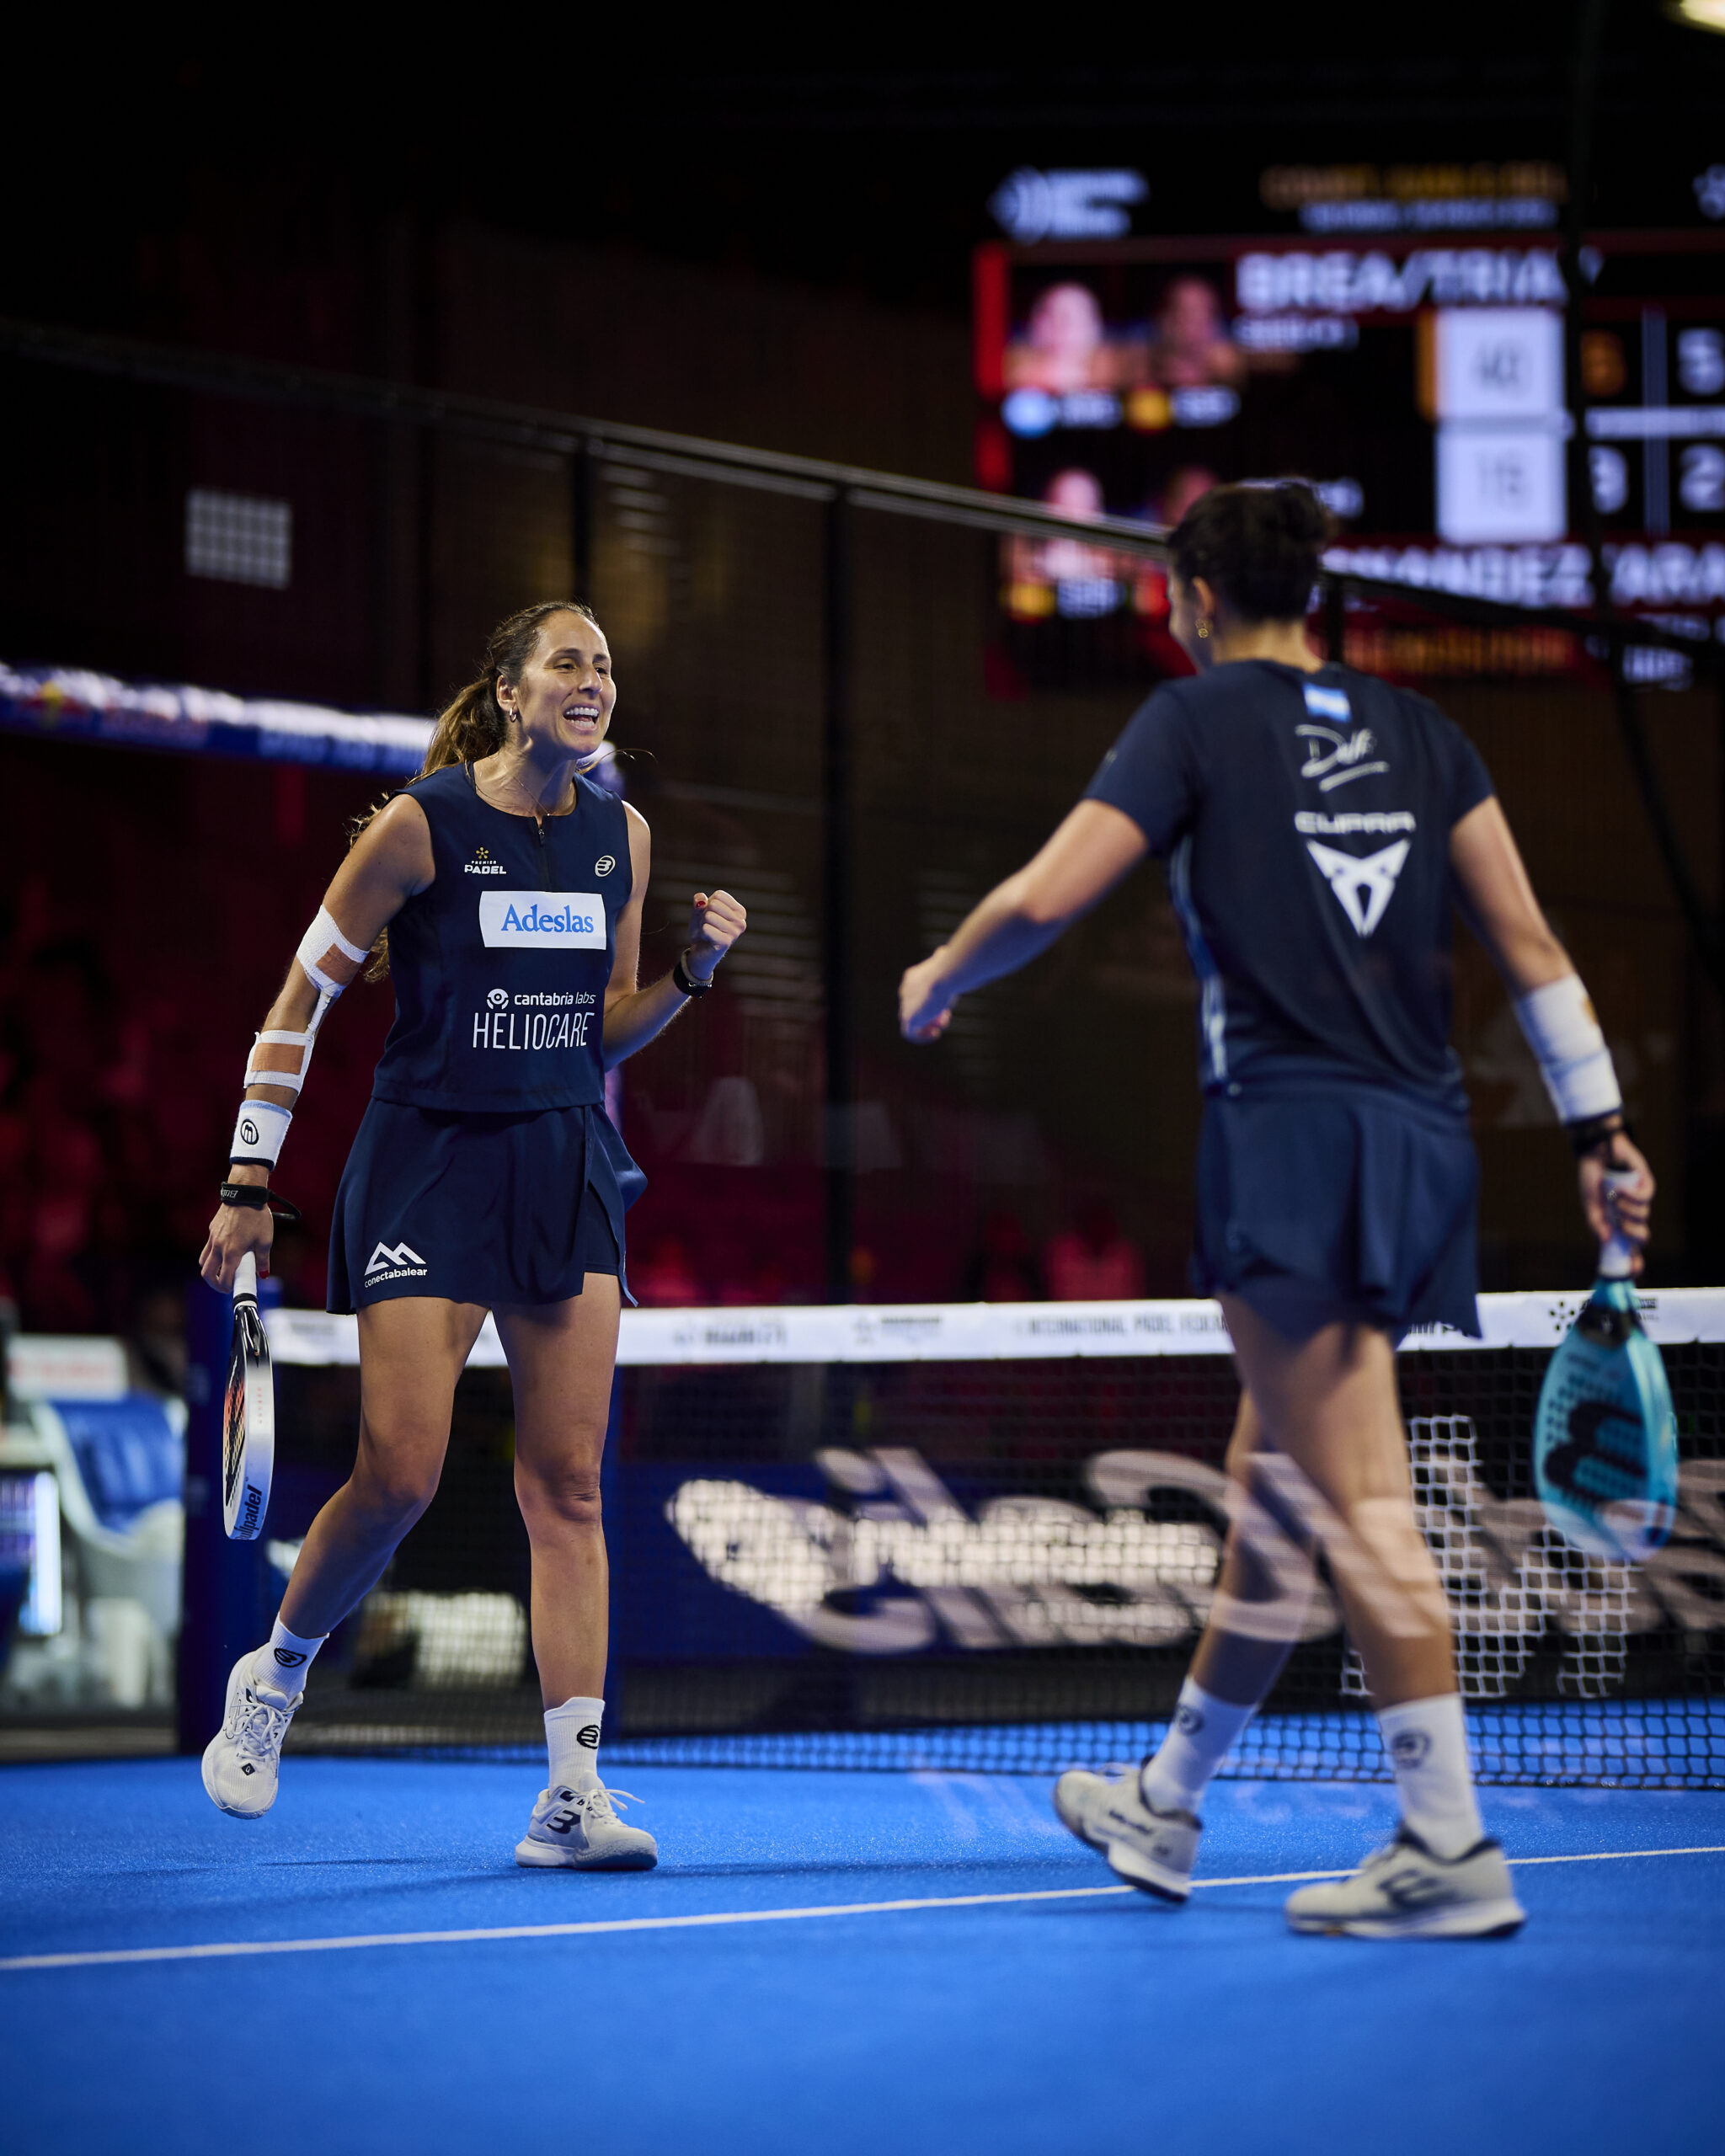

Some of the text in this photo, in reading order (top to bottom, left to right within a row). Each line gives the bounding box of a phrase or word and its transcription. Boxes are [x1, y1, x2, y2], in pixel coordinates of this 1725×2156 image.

[464, 864, 507, 875] PADEL
[500, 904, 595, 933] Adeslas
[514, 991, 596, 1006] cantabria labs
[473, 1012, 595, 1050] HELIOCARE
[364, 1267, 428, 1288] conectabalear
